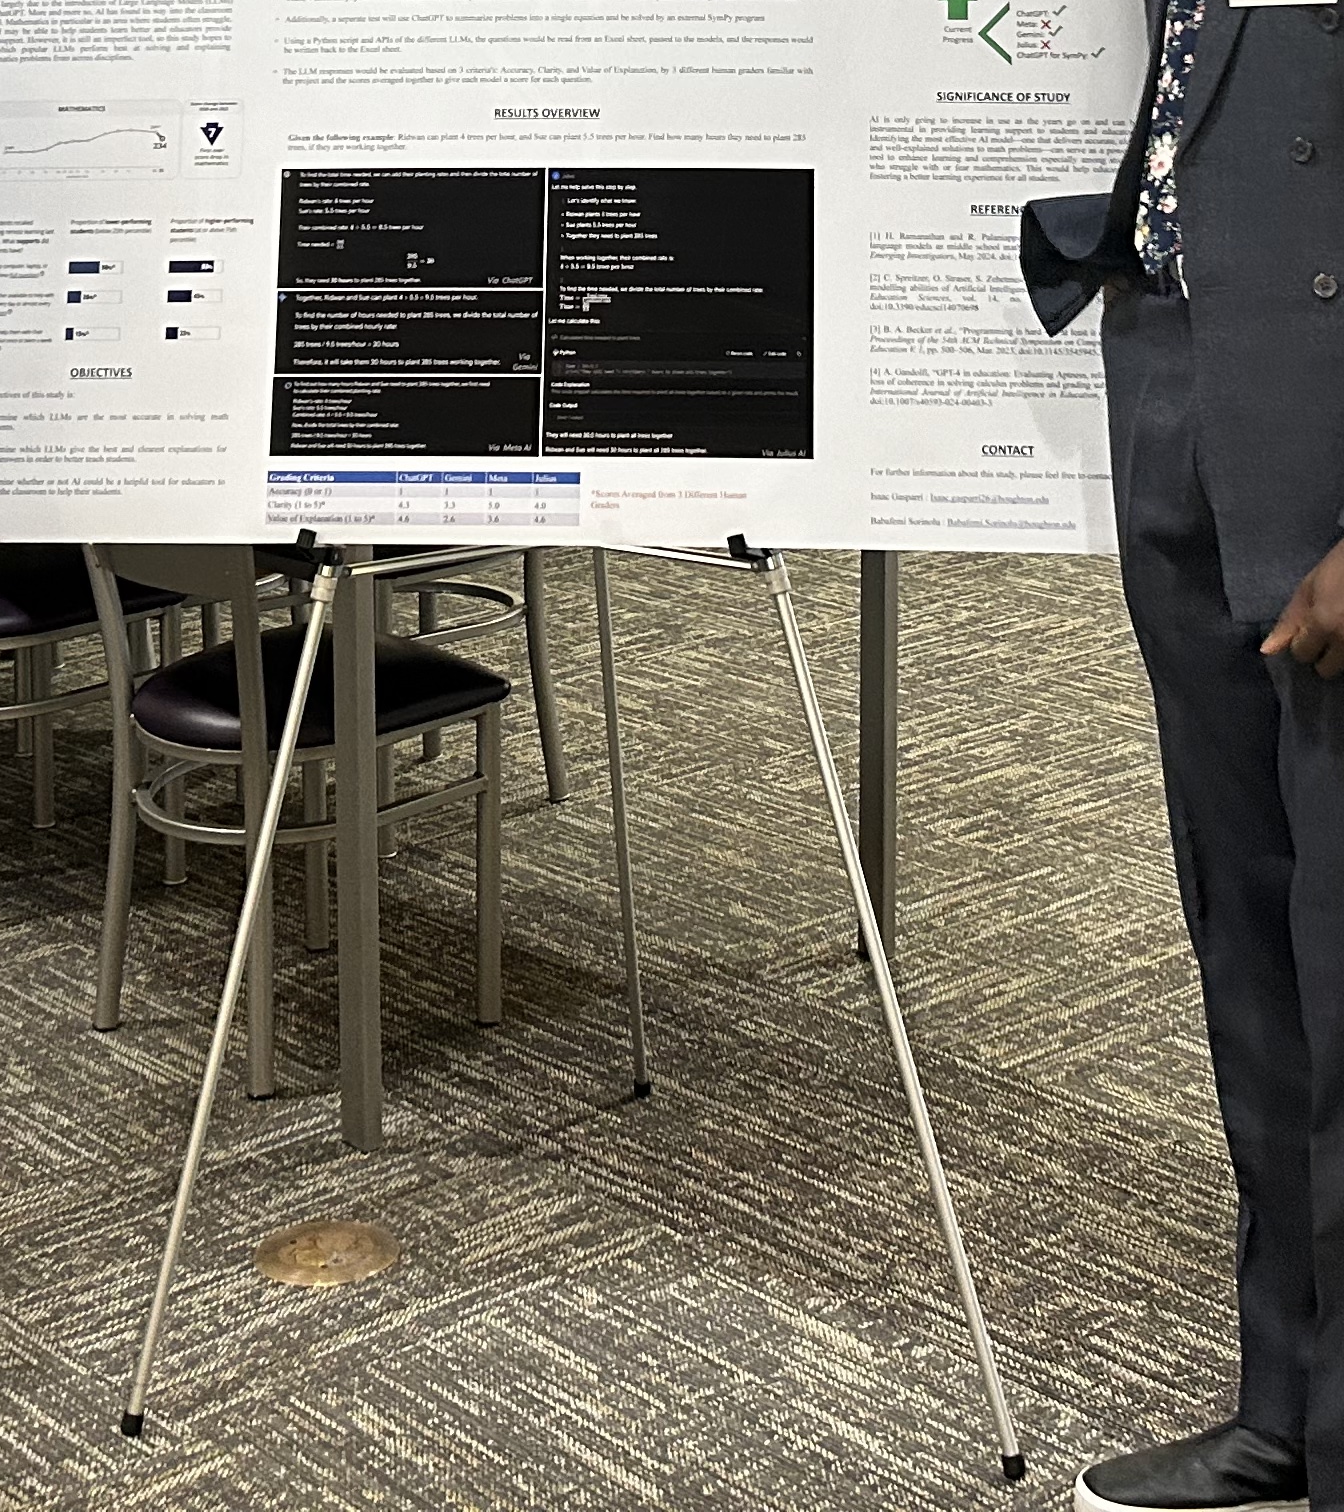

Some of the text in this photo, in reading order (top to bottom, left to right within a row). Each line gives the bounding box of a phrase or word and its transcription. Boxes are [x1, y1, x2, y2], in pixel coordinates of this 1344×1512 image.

[943, 36, 973, 44] Progress
[937, 92, 1071, 103] SIGNIFICANCE OF STUDY
[495, 108, 600, 119] RESULTS OVERVIEW
[207, 127, 216, 138] 7
[70, 368, 132, 378] OBJECTIVES
[982, 445, 1034, 456] CONTACT
[269, 473, 335, 483] Grading Criteria
[398, 473, 433, 482] ChatGPT
[445, 473, 473, 482] Gemini
[489, 473, 508, 482] Meta
[267, 488, 302, 497] Accuracy
[622, 491, 656, 501] Averaged
[658, 491, 676, 499] from
[685, 491, 717, 499] Different
[268, 501, 292, 510] Clarity
[268, 514, 288, 522] Value
[300, 515, 343, 524] Explanation
